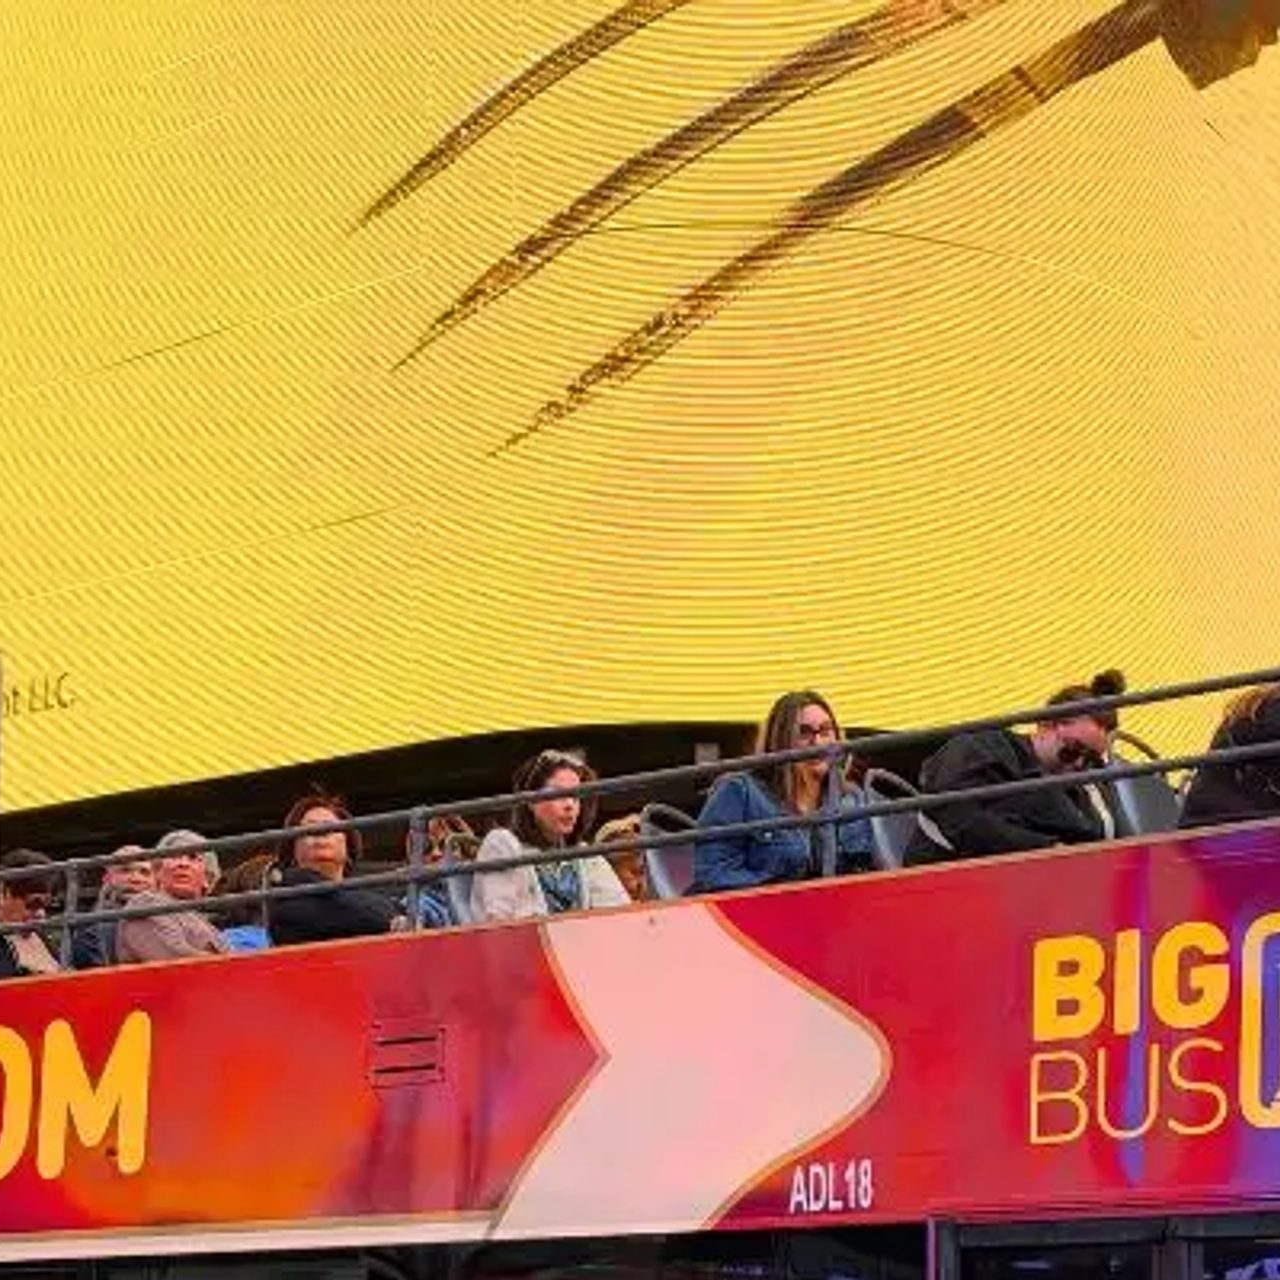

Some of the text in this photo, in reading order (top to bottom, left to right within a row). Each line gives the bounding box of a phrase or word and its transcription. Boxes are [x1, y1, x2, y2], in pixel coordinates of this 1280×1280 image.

[1031, 920, 1231, 1042] BIG
[1028, 1037, 1228, 1145] BUS
[789, 1158, 874, 1214] ADL 18
